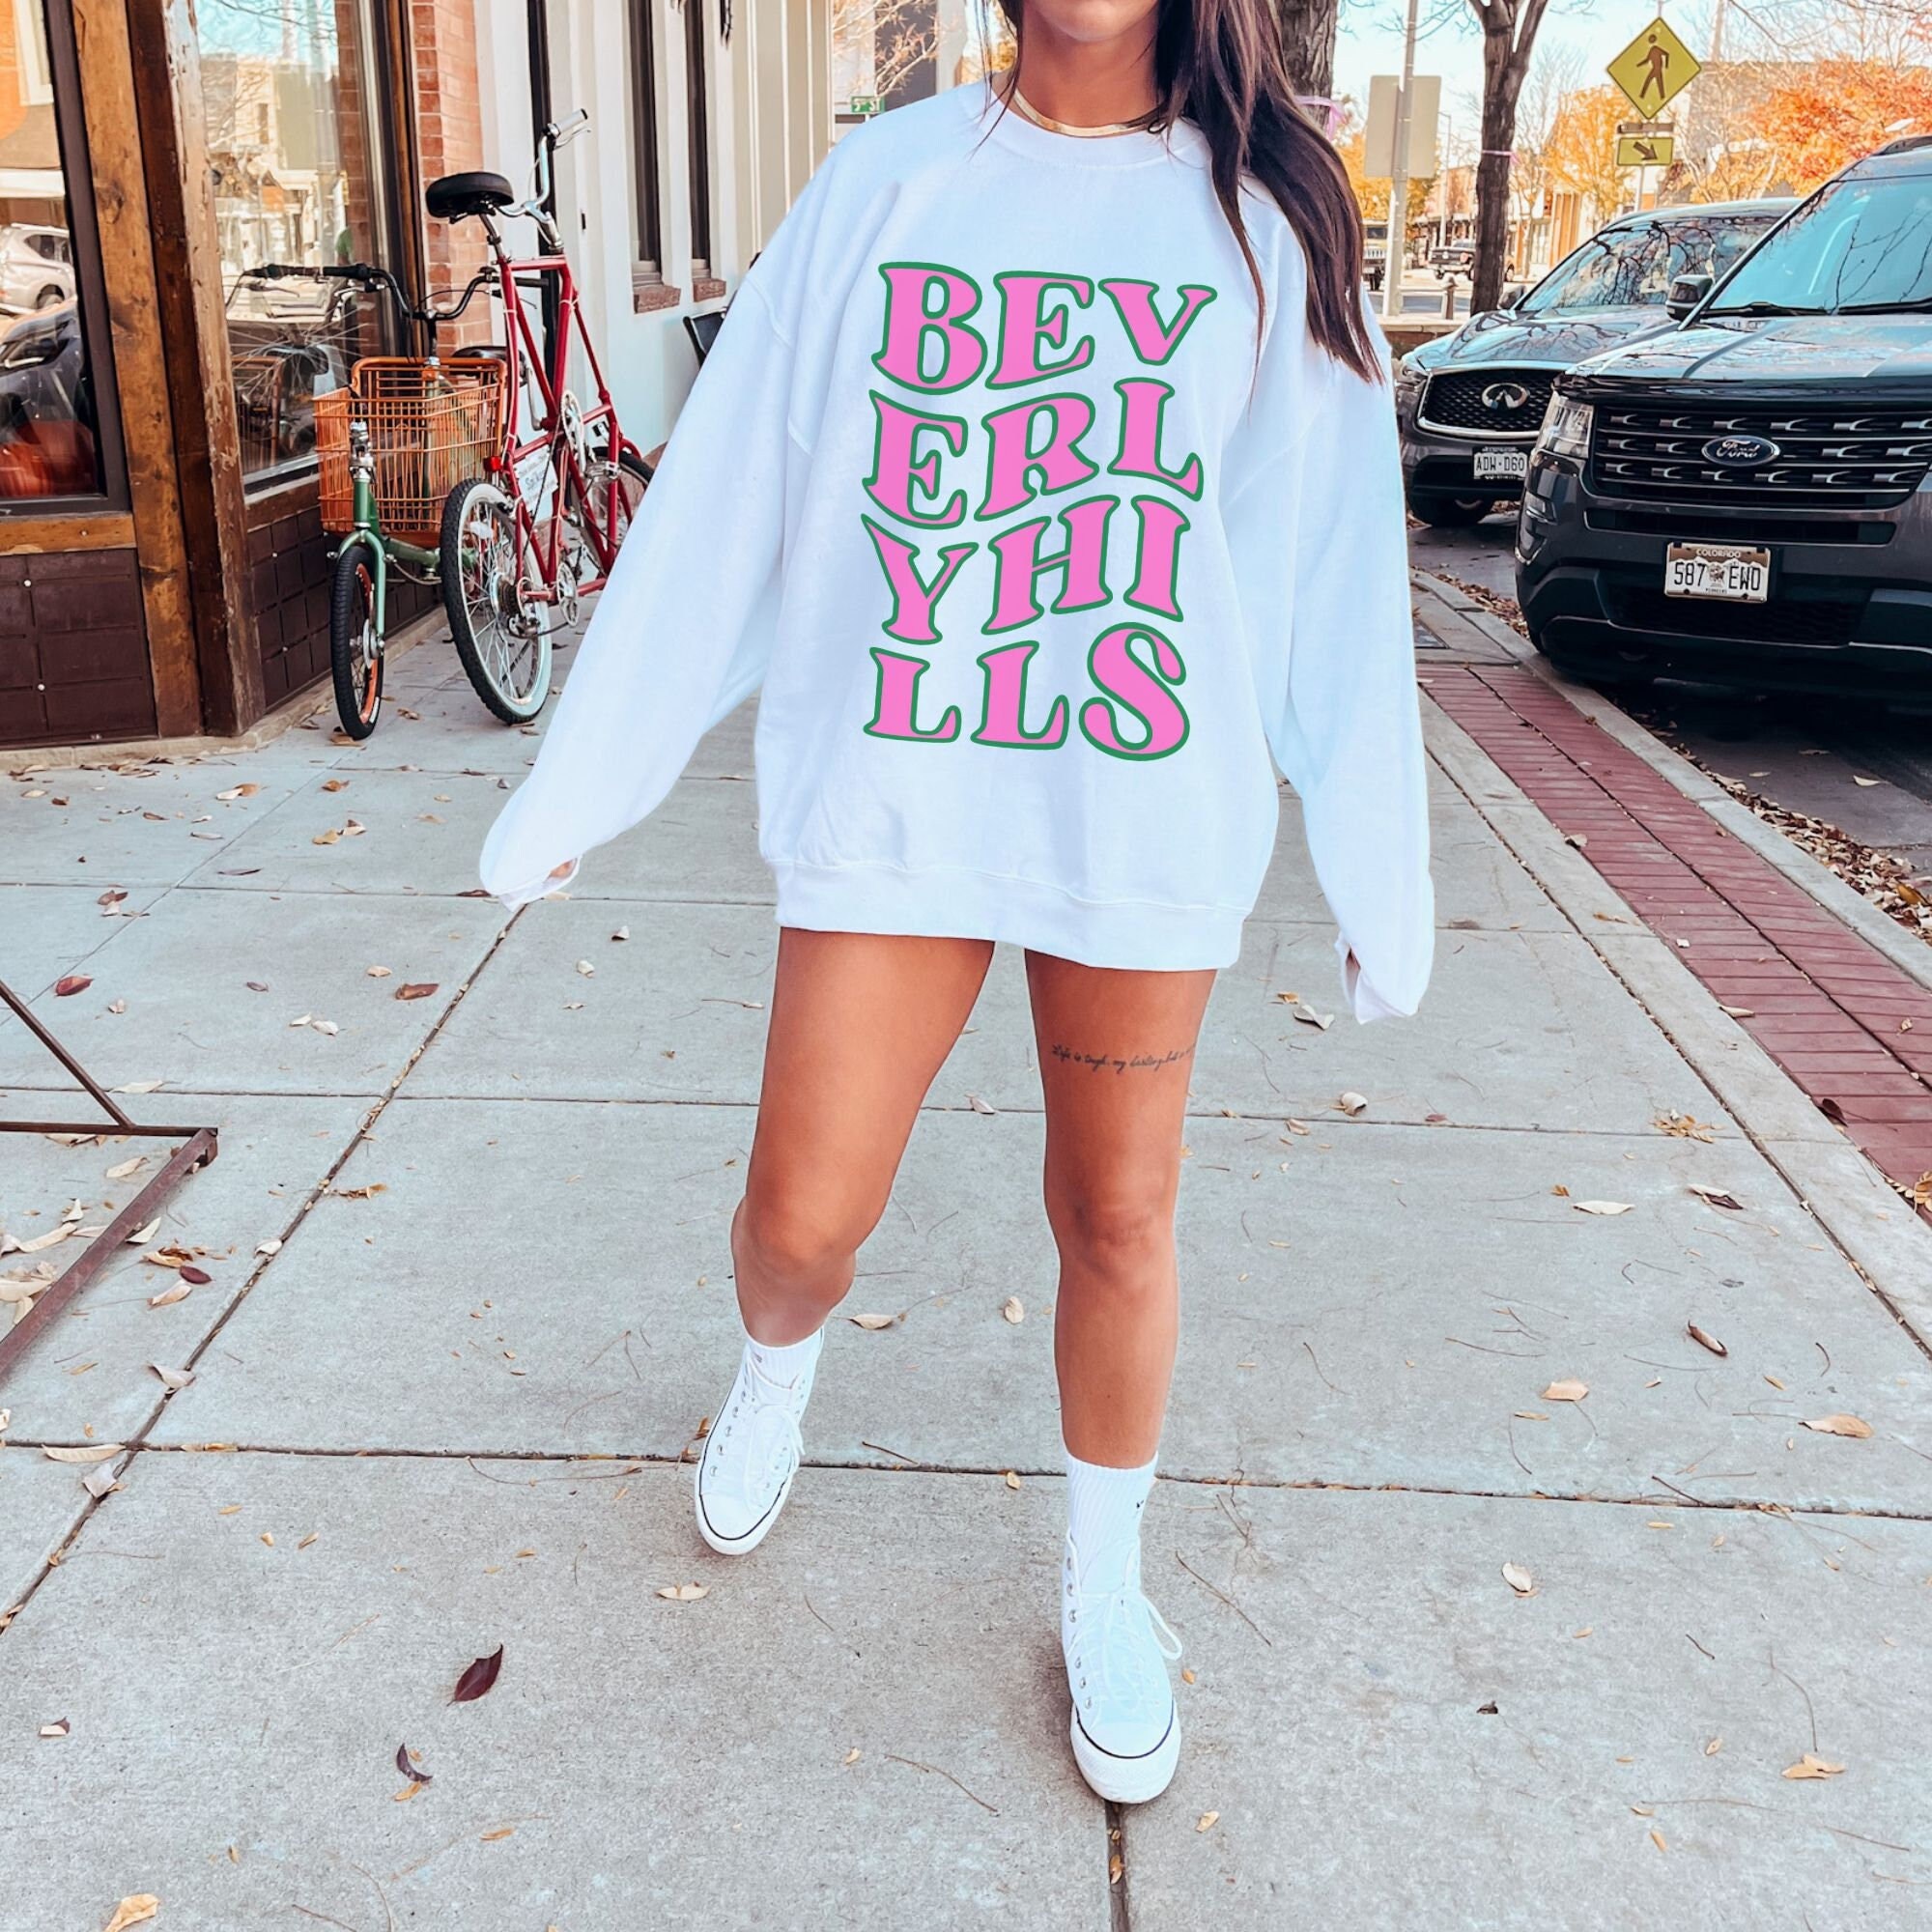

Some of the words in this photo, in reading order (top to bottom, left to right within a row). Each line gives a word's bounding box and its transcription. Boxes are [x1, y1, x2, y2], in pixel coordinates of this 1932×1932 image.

[871, 262, 1219, 396] BEV
[862, 377, 1205, 530] ERL
[1716, 439, 1761, 458] Ford
[860, 495, 1191, 646] YHI
[1673, 561, 1707, 587] 587
[1695, 548, 1742, 558] COLORADO
[862, 621, 1191, 762] LLS
